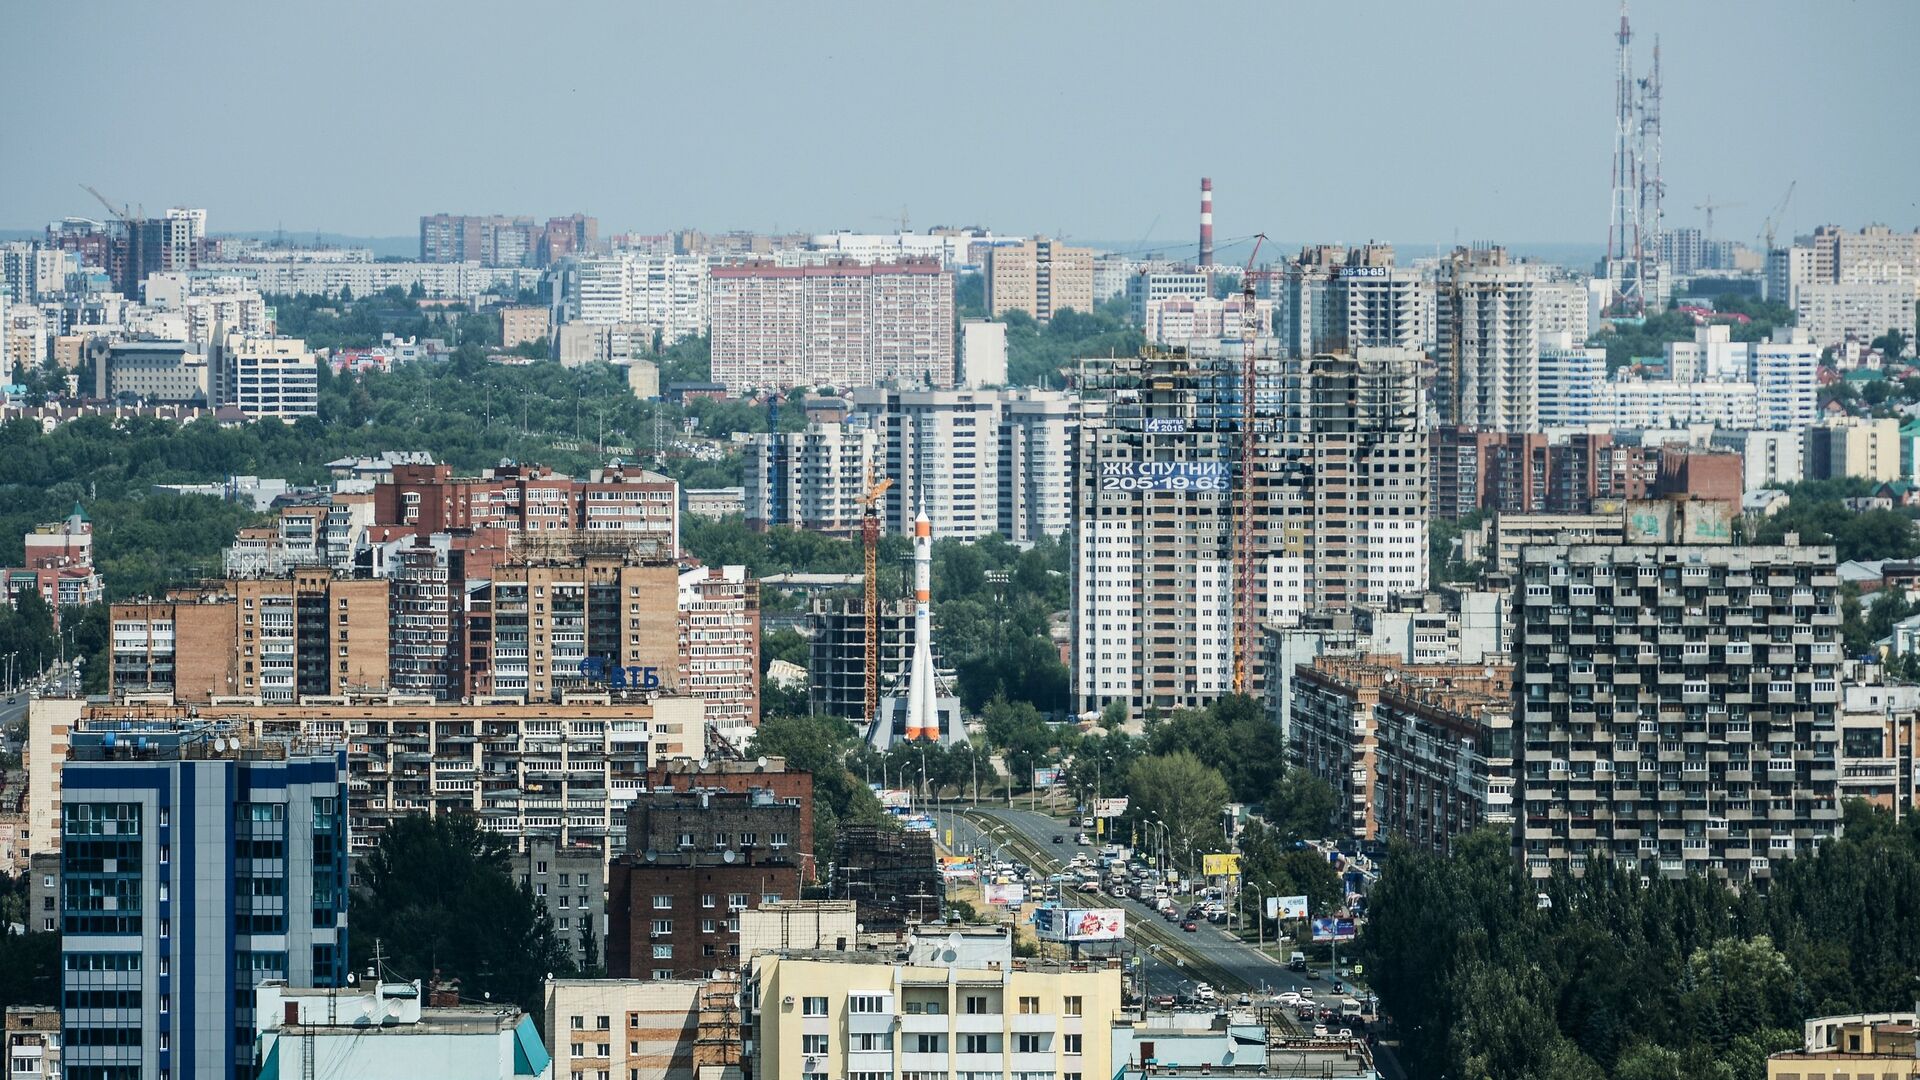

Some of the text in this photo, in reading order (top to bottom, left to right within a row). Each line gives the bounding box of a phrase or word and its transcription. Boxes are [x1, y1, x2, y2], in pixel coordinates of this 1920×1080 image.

[1149, 418, 1159, 432] 4
[1103, 462, 1230, 475] ЖК СПУТНИК
[611, 666, 659, 688] ВТБ
